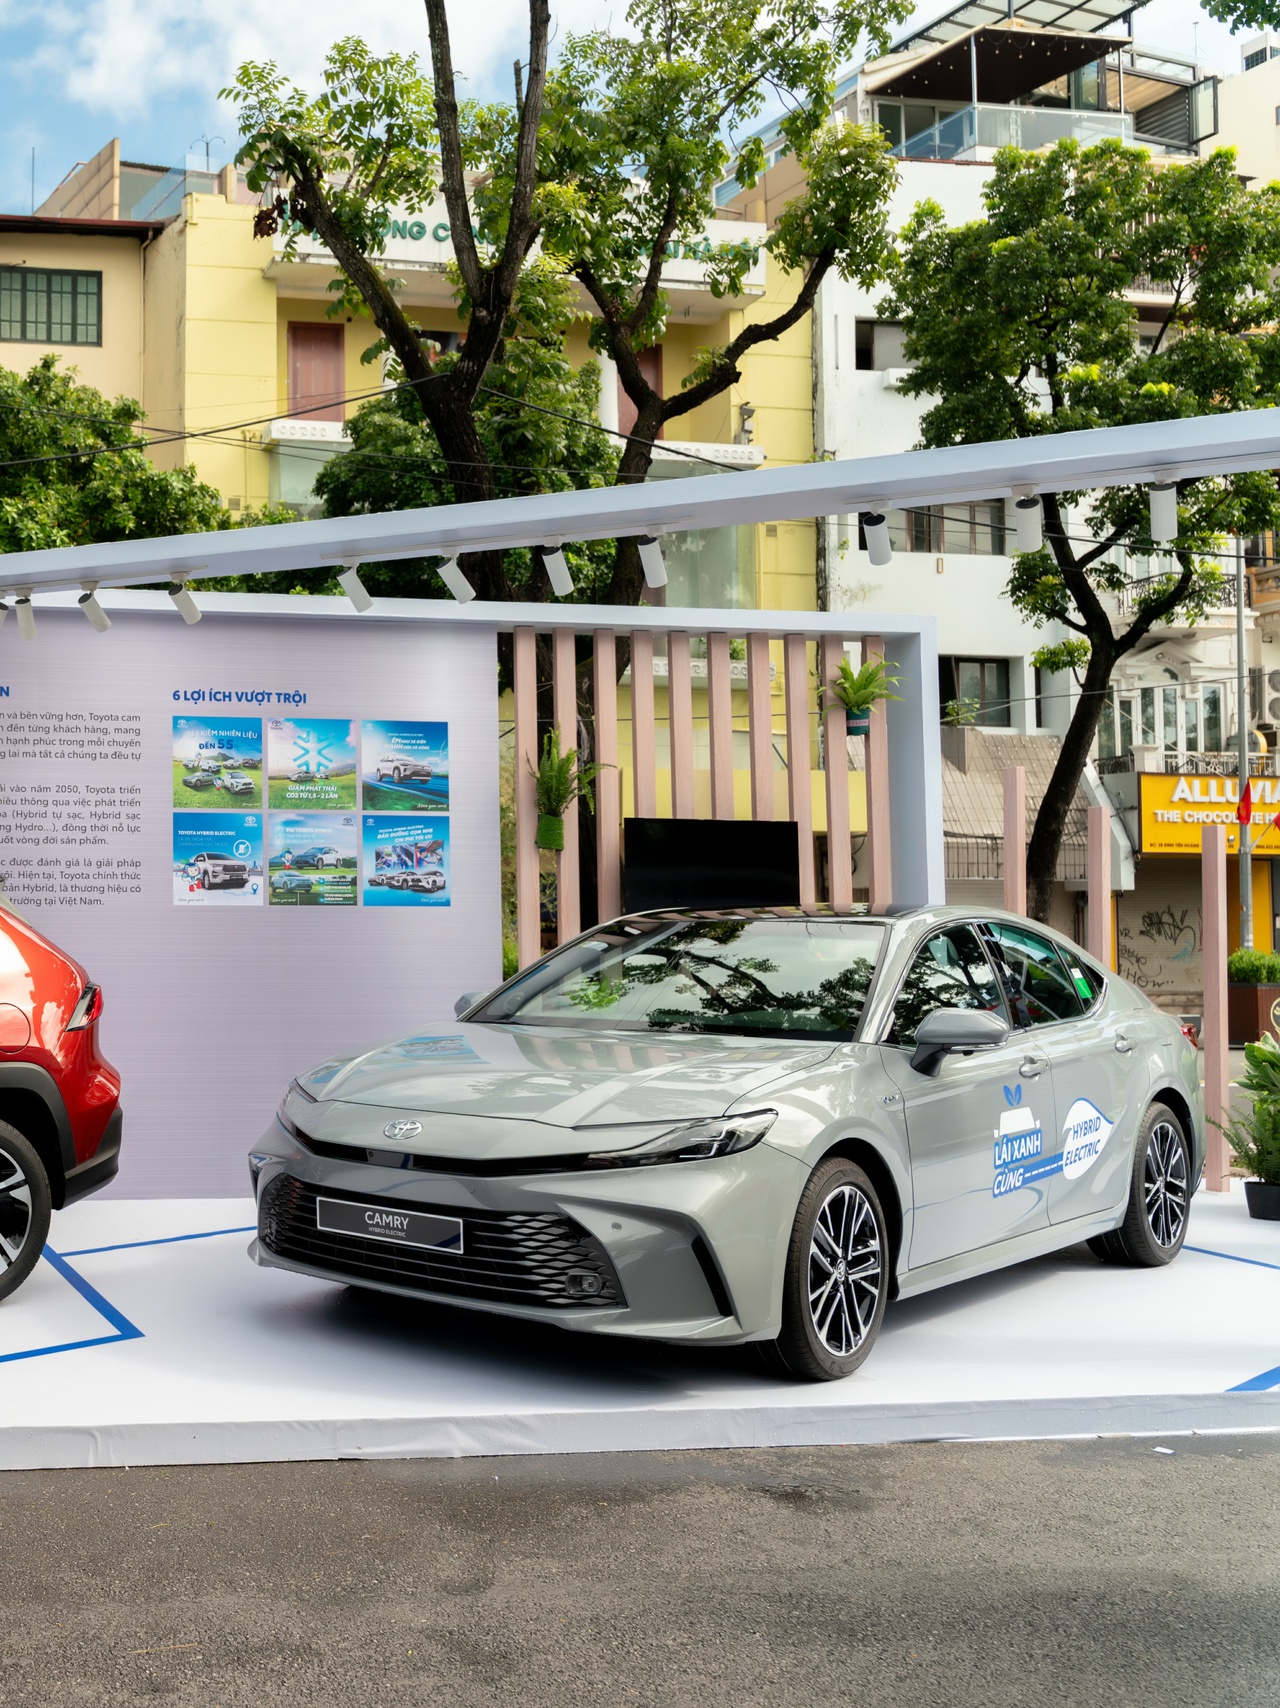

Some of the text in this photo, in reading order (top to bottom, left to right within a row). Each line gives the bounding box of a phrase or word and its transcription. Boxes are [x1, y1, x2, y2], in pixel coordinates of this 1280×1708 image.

[172, 688, 307, 707] 6 LỢI ÍCH VƯỢT TRỘI
[6, 710, 18, 720] và
[20, 710, 38, 720] bền
[40, 711, 63, 723] vững
[66, 711, 87, 722] hơn,
[88, 711, 119, 723] Toyota
[121, 714, 141, 722] cam
[6, 722, 25, 732] đến
[28, 723, 50, 735] từng
[53, 724, 81, 733] khách
[84, 724, 111, 736] hàng,
[114, 727, 141, 737] mang
[219, 729, 241, 737] NHIÊN
[242, 731, 258, 739] LIỆU
[6, 736, 30, 747] hạnh
[32, 736, 57, 748] phúc
[58, 737, 85, 748] trong
[87, 736, 105, 746] mỗi
[107, 737, 141, 749] chuyến
[198, 741, 216, 750] ĐẾN
[8, 748, 19, 758] lai
[22, 749, 37, 758] mà
[39, 748, 53, 758] tất
[54, 749, 65, 759] cả
[67, 749, 97, 761] chúng
[99, 751, 109, 759] ta
[110, 750, 129, 760] đều
[131, 751, 141, 762] tự
[1154, 809, 1182, 823] THE
[1183, 810, 1264, 824] CHOCOLTE
[16, 835, 40, 847] vòng
[42, 836, 58, 845] đời
[60, 836, 77, 845] sản
[79, 836, 109, 848] phẩm.
[9, 857, 33, 868] được
[36, 857, 61, 867] đánh
[65, 858, 80, 869] giá
[84, 858, 92, 867] là
[96, 858, 113, 870] giải
[116, 859, 141, 870] pháp
[18, 869, 40, 881] Hiện
[42, 870, 57, 881] tại,
[59, 870, 90, 882] Toyota
[92, 871, 118, 880] chính
[120, 871, 141, 881] thức
[22, 882, 57, 894] Hybrid,
[60, 883, 68, 892] là
[70, 883, 105, 895] thương
[107, 884, 127, 895] hiệu
[130, 884, 141, 894] có
[9, 895, 104, 907] trường tại Việt Nam.
[1072, 1116, 1102, 1141] HYBRID
[995, 1132, 1041, 1166] LÁI XANH
[1064, 1139, 1101, 1167] ELECTRIC
[994, 1168, 1024, 1195] CÙNG
[364, 1211, 410, 1230] CAMRY
[368, 1226, 406, 1238] HYBRID ELECTRIC
